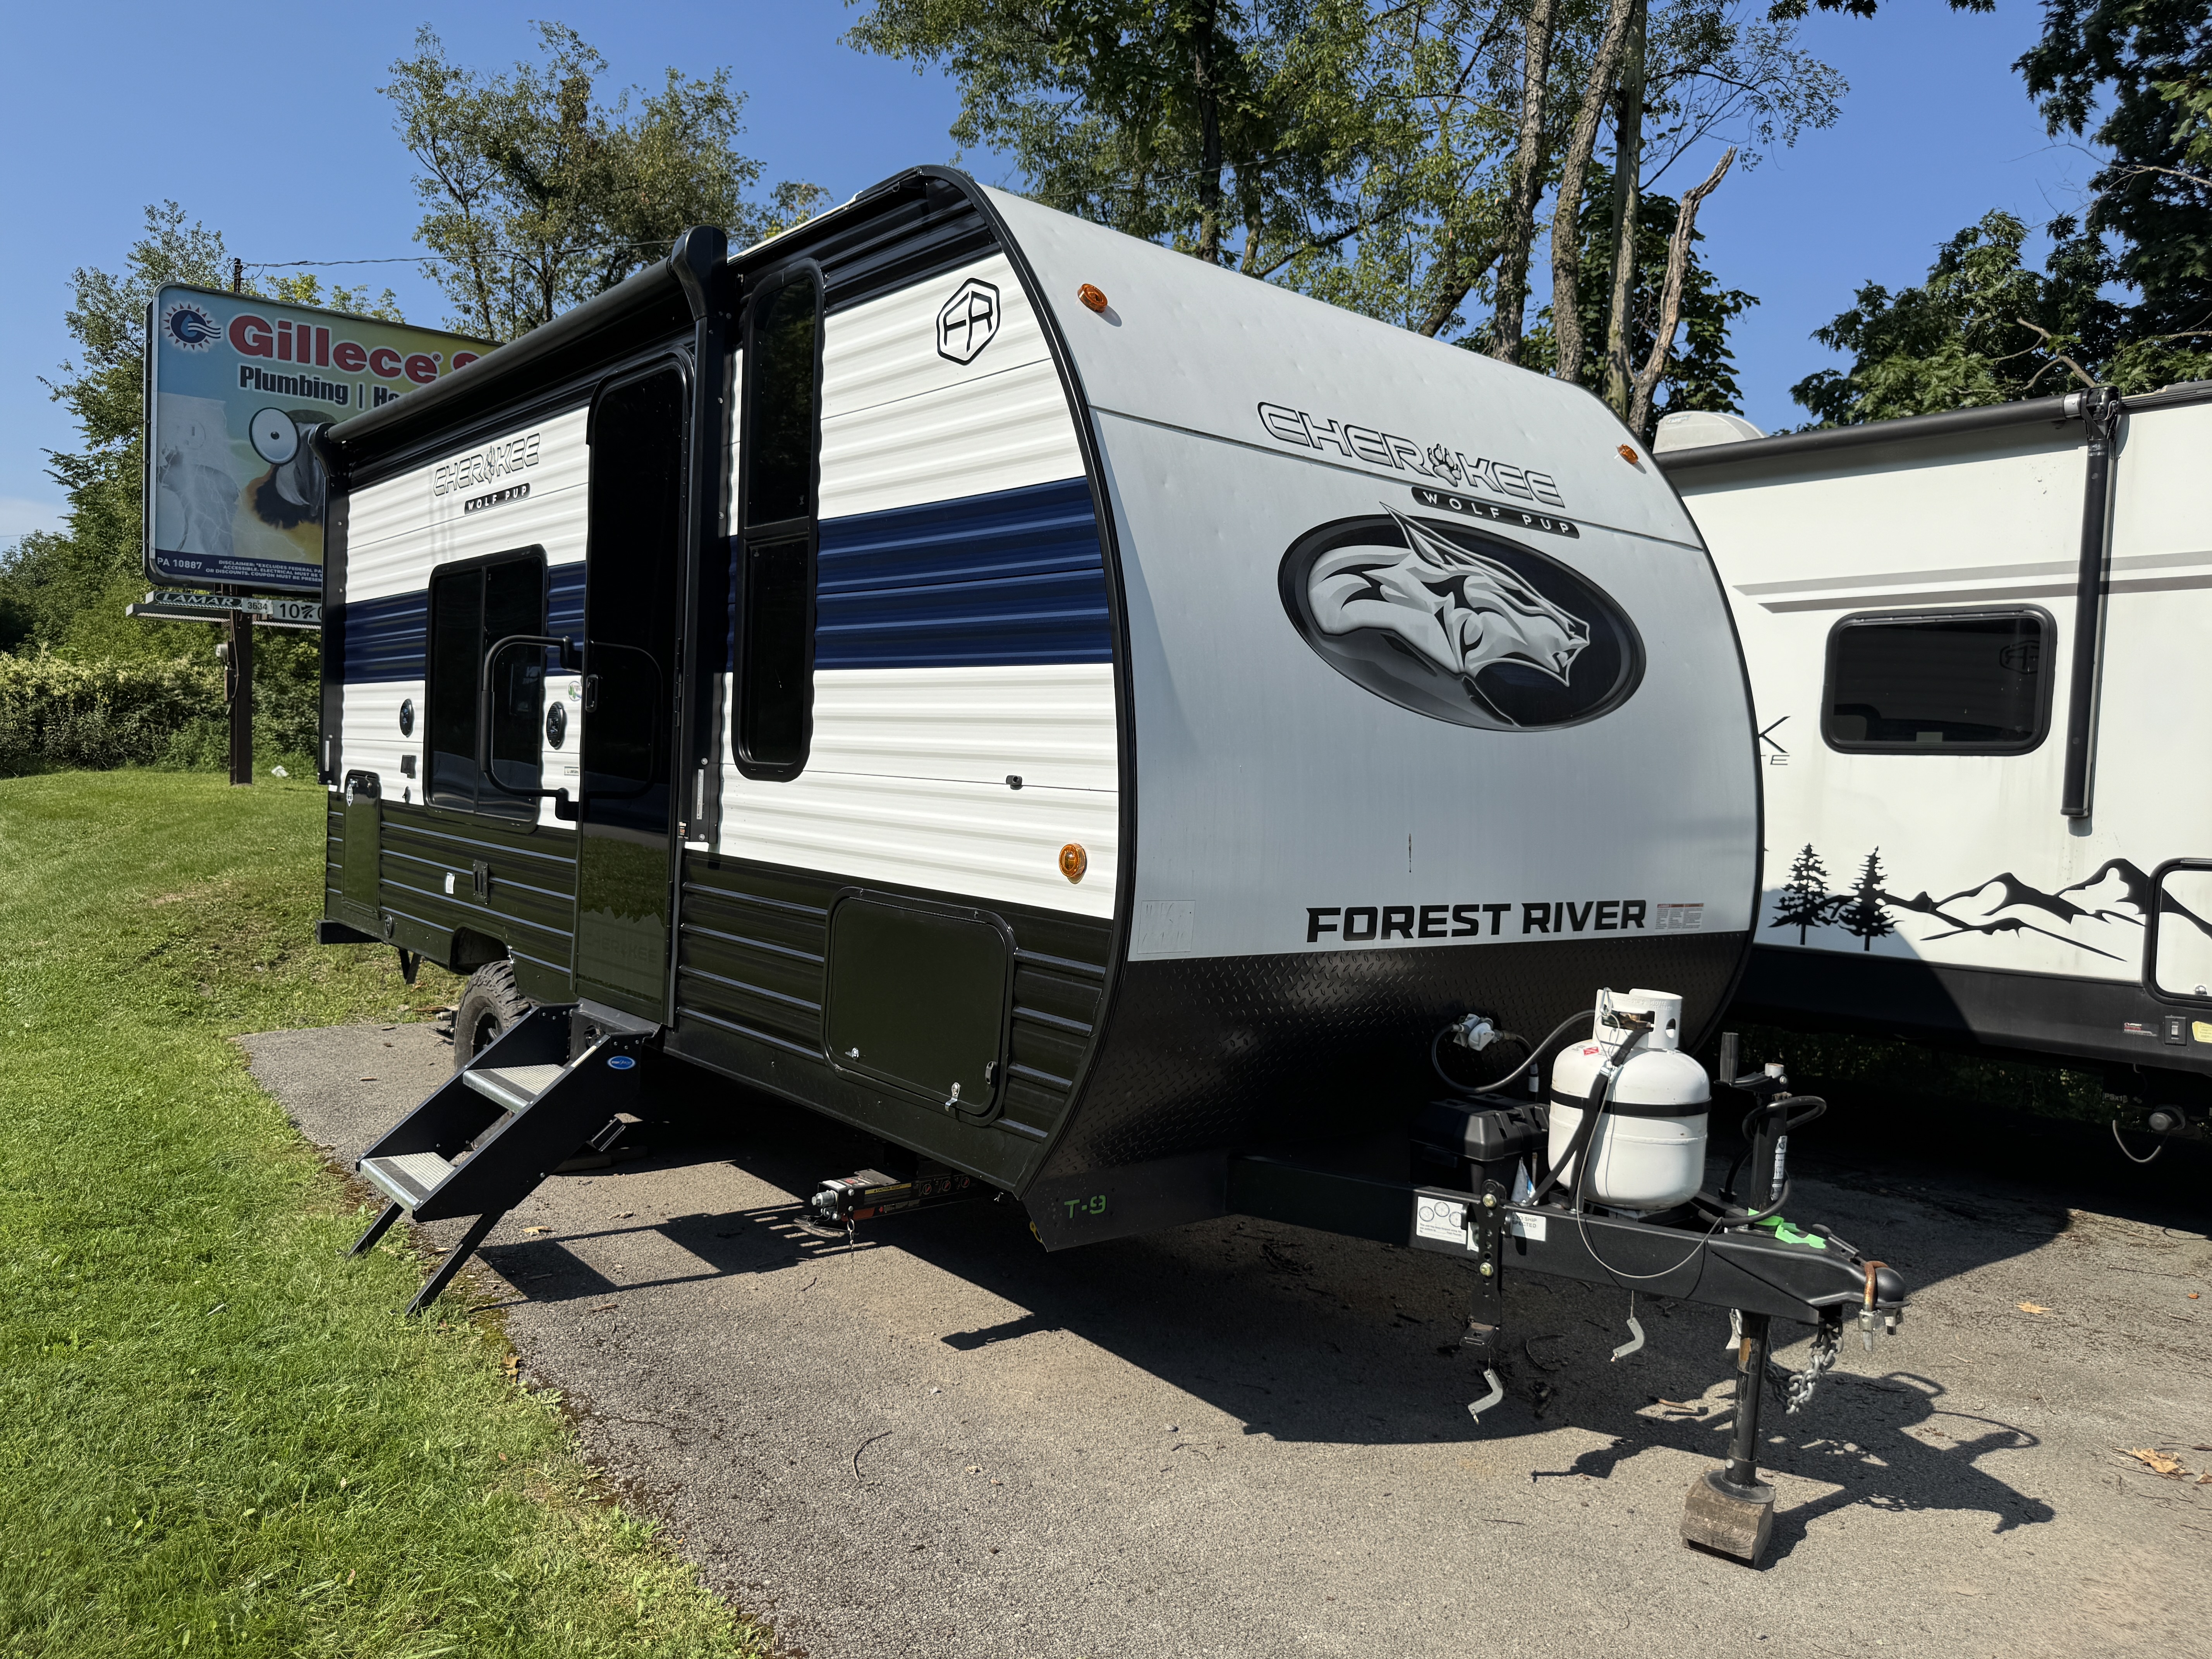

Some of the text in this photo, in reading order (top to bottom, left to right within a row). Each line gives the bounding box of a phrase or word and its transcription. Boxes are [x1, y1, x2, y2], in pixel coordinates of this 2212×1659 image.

[240, 365, 348, 405] Plumbing
[468, 486, 527, 511] WOLF PUP
[1422, 491, 1569, 533] WOLF PUP
[157, 557, 202, 570] PA 10887
[163, 594, 234, 606] LAMAR
[247, 601, 268, 610] 3634
[1759, 716, 1791, 753] K
[1306, 903, 1511, 943] FOREST
[1521, 900, 1646, 934] RIVER
